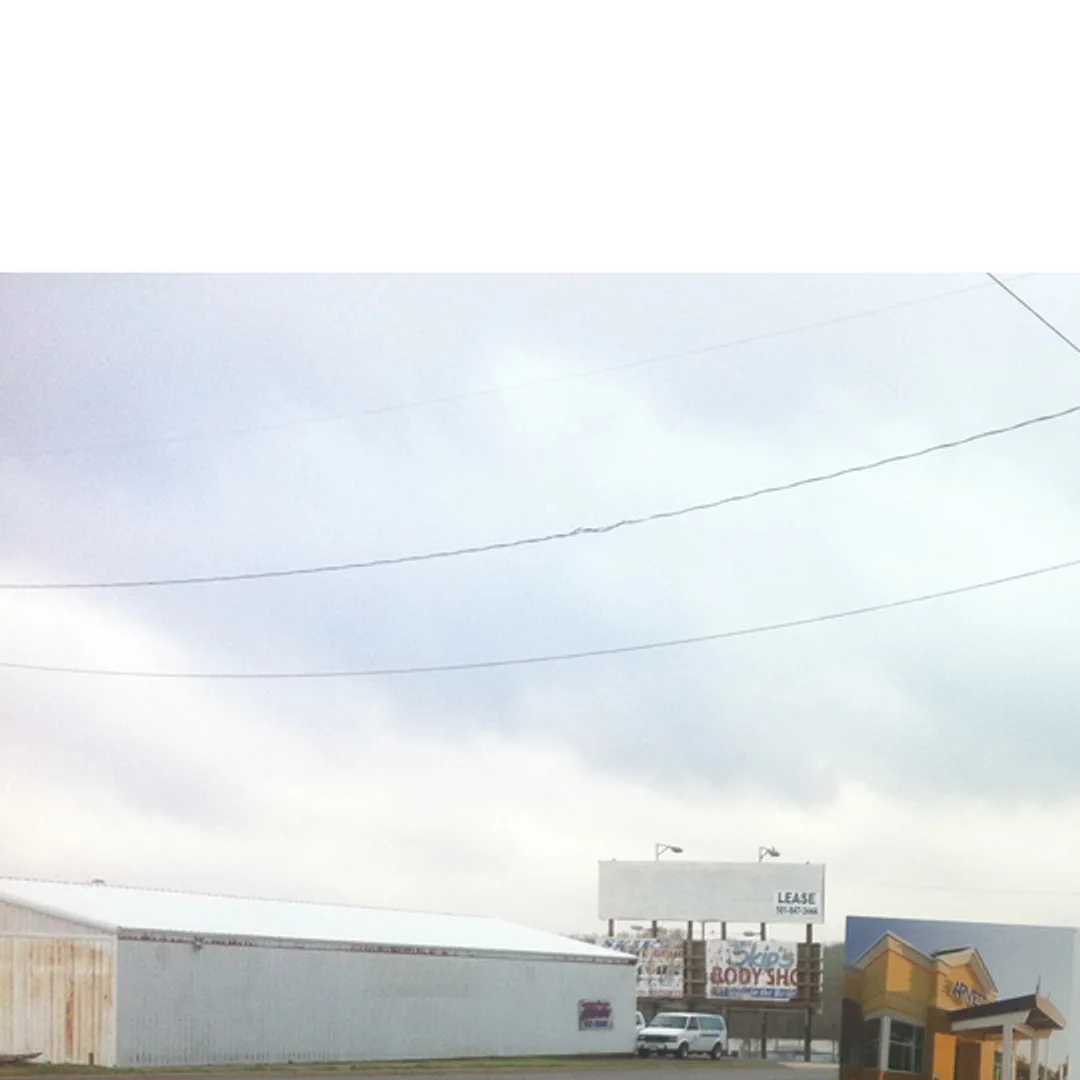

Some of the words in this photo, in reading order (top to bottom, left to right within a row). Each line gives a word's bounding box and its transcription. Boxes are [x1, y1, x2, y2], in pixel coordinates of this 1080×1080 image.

[778, 891, 816, 905] LEASE
[710, 966, 760, 985] BODY
[767, 968, 799, 987] SHO
